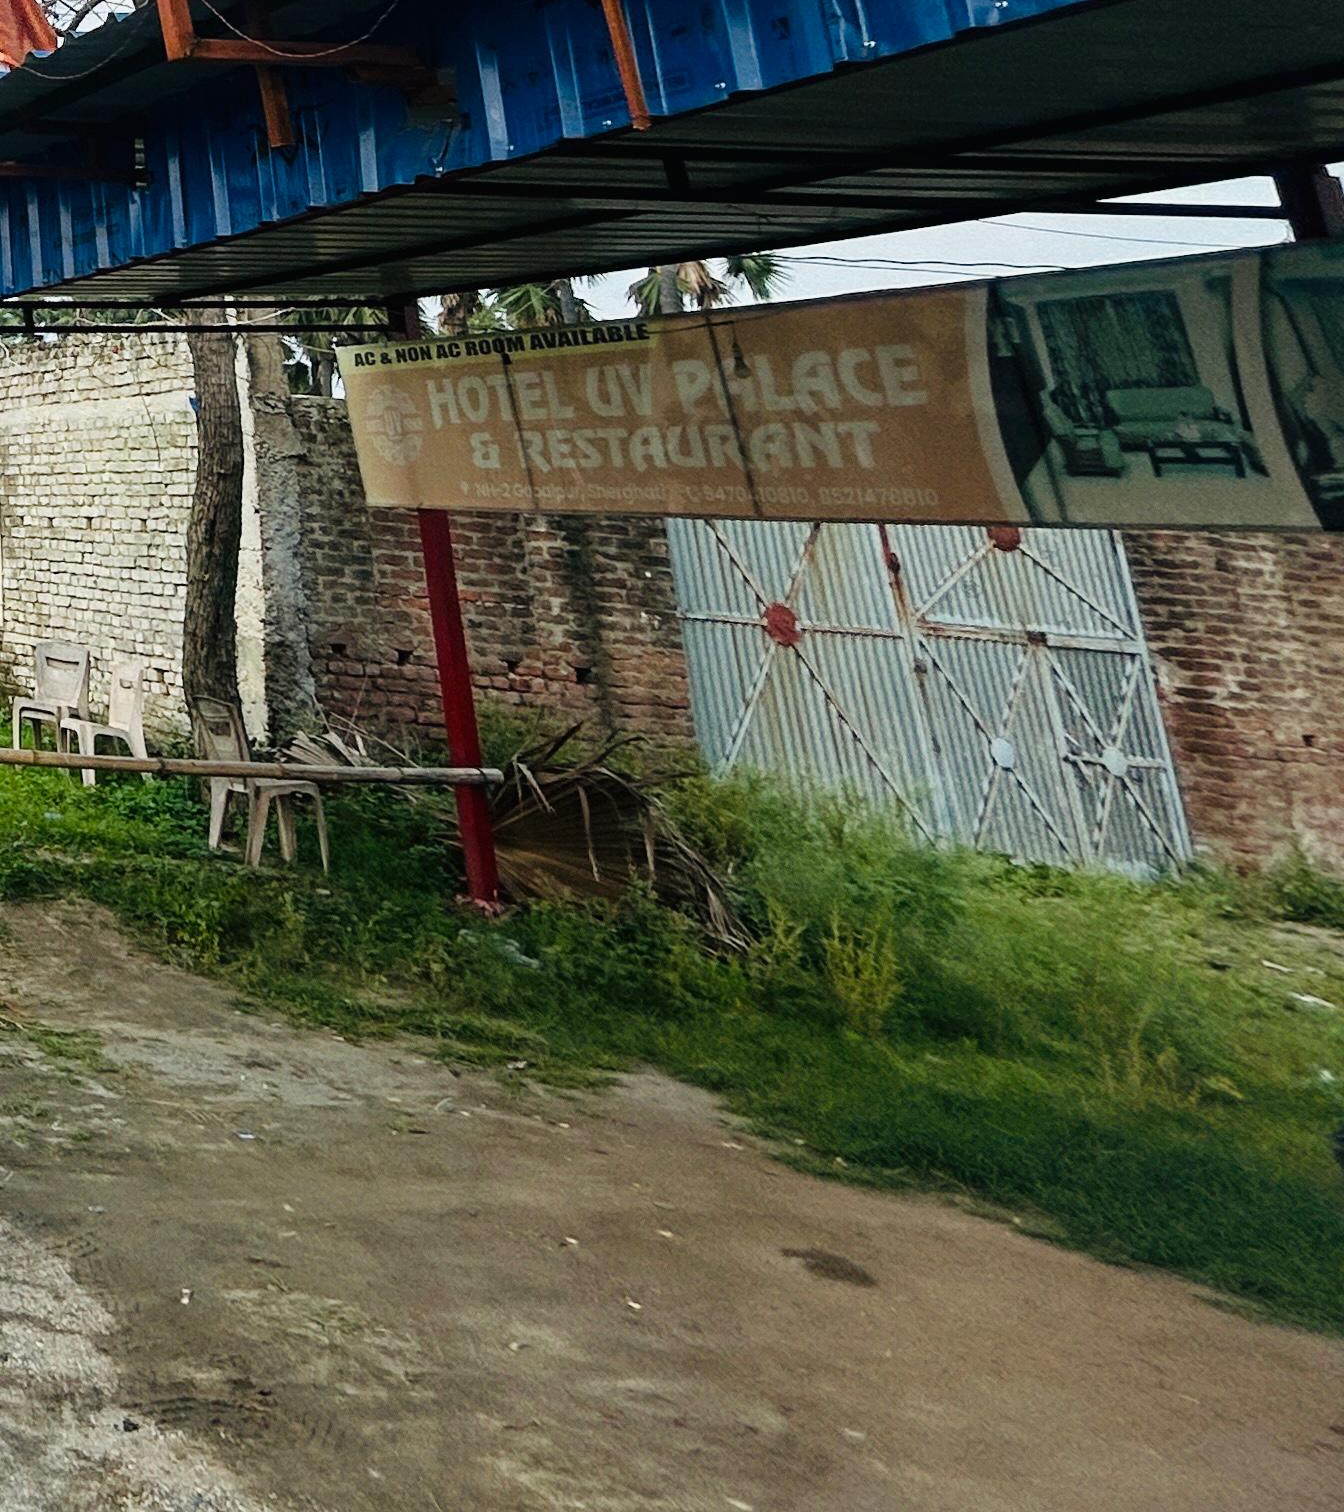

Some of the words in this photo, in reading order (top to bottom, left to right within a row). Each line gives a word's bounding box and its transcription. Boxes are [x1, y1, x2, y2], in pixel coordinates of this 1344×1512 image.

[354, 351, 376, 367] AC
[379, 351, 393, 365] &
[396, 345, 433, 365] NON
[436, 342, 461, 360] AC
[464, 334, 526, 357] ROOM
[530, 322, 651, 351] AVAILABLE
[425, 370, 576, 431] HOTEL
[585, 363, 653, 418] UV
[672, 343, 929, 417] PALACE
[469, 431, 502, 470] &
[514, 420, 882, 473] RESTAURANT
